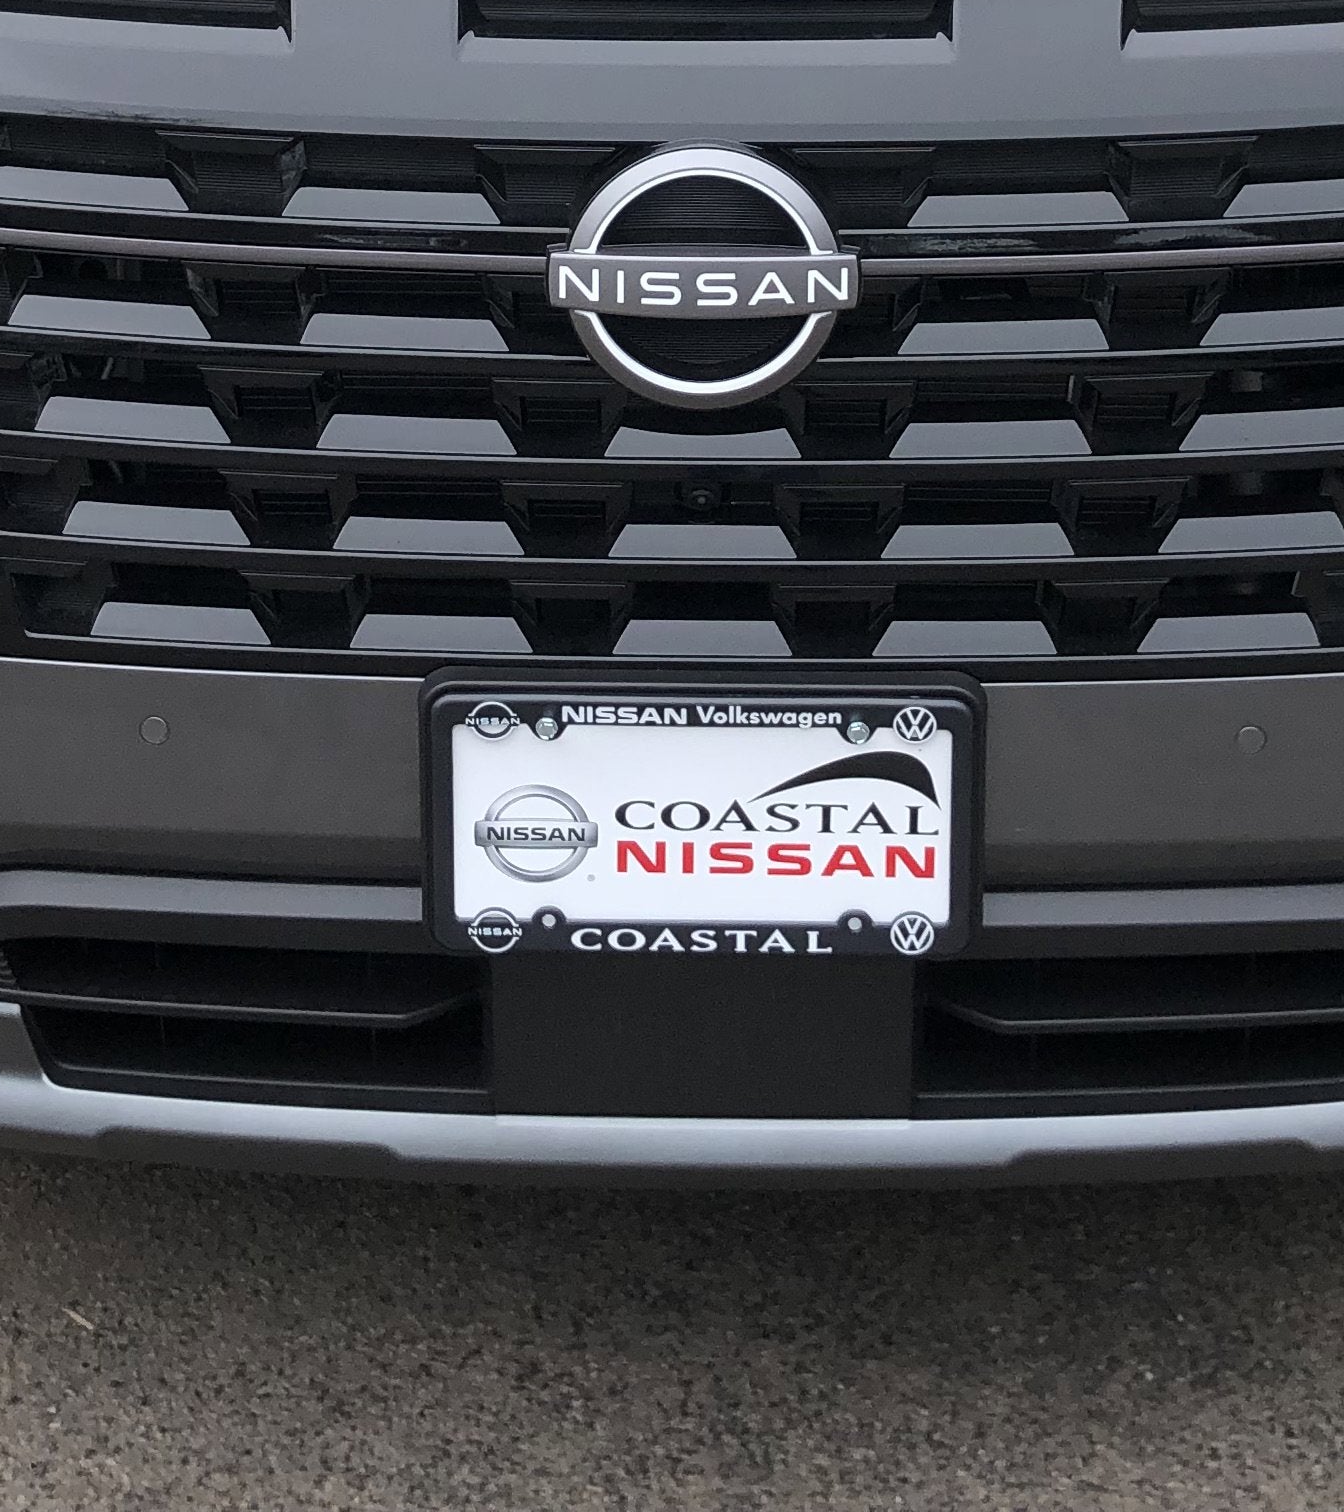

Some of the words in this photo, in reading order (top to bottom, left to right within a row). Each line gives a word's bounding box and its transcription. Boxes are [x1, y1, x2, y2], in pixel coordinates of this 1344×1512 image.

[558, 265, 849, 307] NISSAN
[465, 716, 521, 726] NISSAN
[561, 705, 687, 725] NISSAN
[696, 705, 843, 729] Volkswagen
[613, 798, 941, 836] COASTAL
[486, 825, 587, 843] NISSAN
[616, 840, 936, 879] NISSAN
[467, 926, 523, 937] NISSAN
[570, 927, 833, 954] COASTAL
